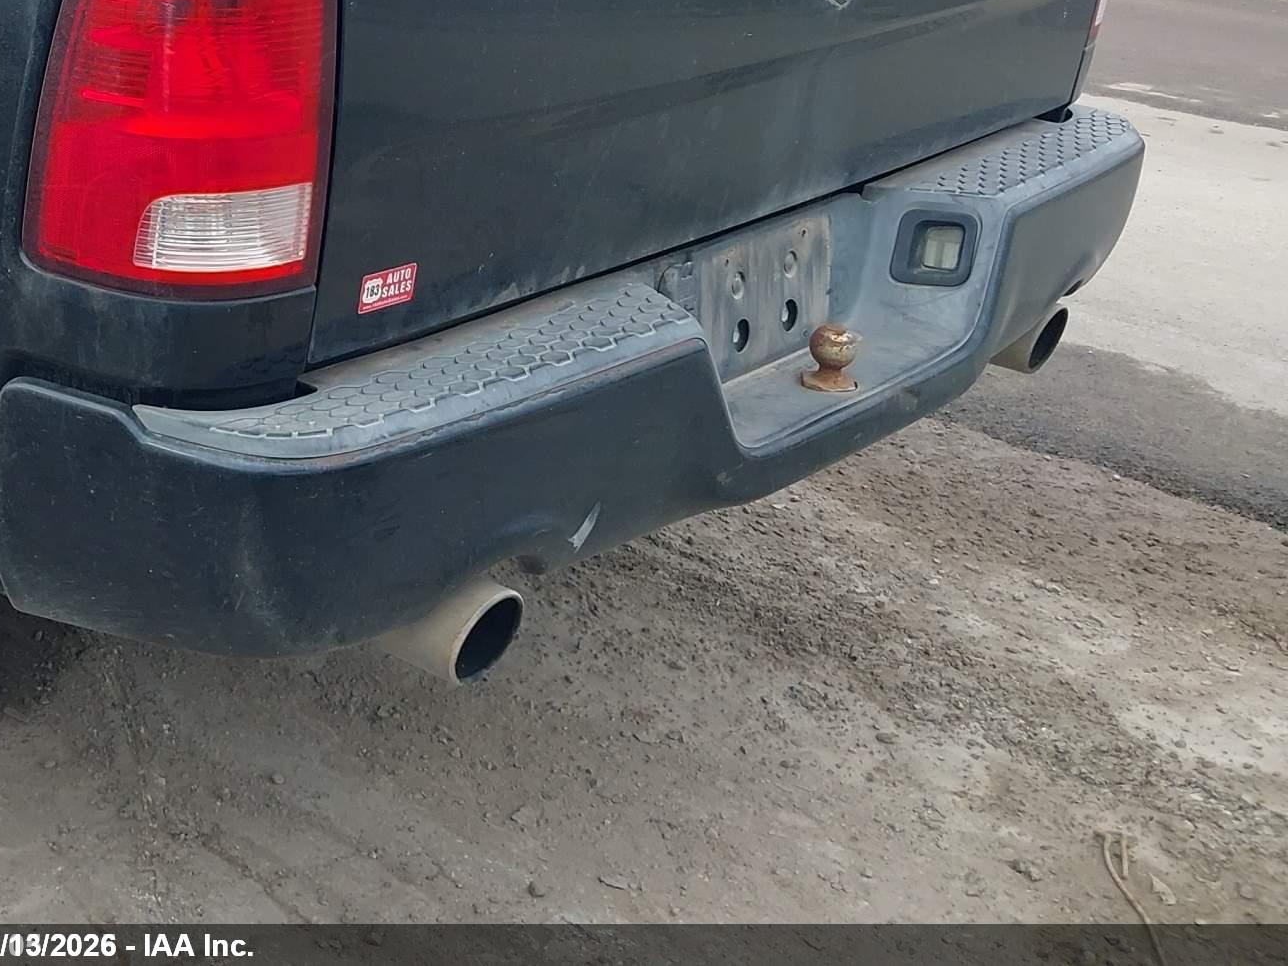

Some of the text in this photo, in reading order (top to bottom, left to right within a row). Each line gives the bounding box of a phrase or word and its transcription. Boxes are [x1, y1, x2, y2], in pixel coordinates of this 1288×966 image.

[386, 268, 412, 285] AUTO
[365, 284, 380, 299] 183
[382, 280, 412, 298] SALES
